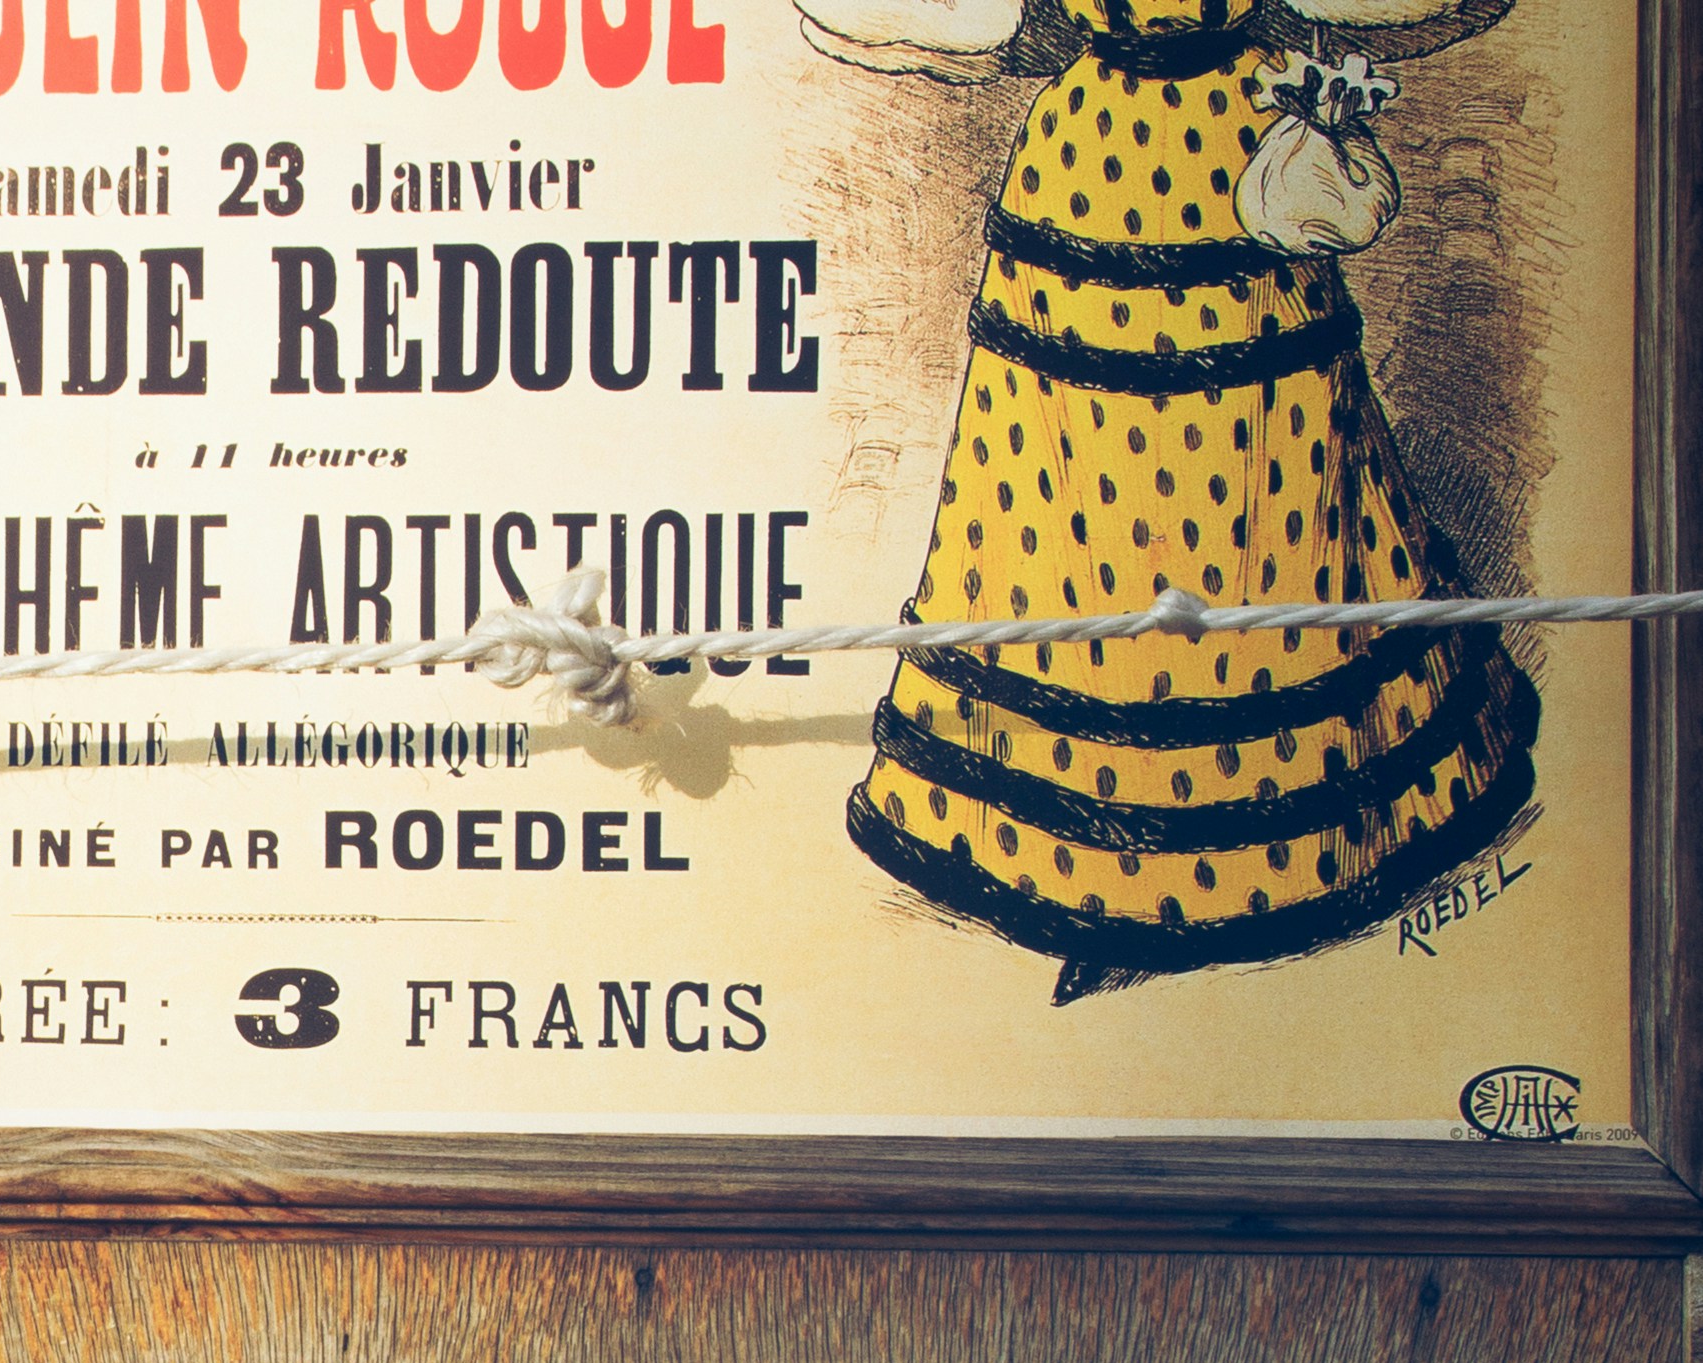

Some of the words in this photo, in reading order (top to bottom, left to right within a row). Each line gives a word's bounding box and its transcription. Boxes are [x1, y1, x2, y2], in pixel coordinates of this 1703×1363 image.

[218, 141, 305, 219] 23
[351, 139, 596, 216] Janvier
[271, 239, 820, 393] REDOUTE
[135, 441, 159, 469] à
[191, 442, 238, 469] 11
[269, 441, 409, 469] heures
[288, 509, 810, 676] ARTISTIQUE
[7, 713, 169, 768] DÉFILÉ
[205, 714, 530, 777] ALLÉGORIQUE
[160, 829, 279, 869] PAR
[324, 809, 690, 872] ROEDEL
[1398, 856, 1533, 957] ROEDEL
[233, 966, 342, 1050] 3
[405, 979, 768, 1053] FRANCS
[1606, 1127, 1638, 1142] 2009
